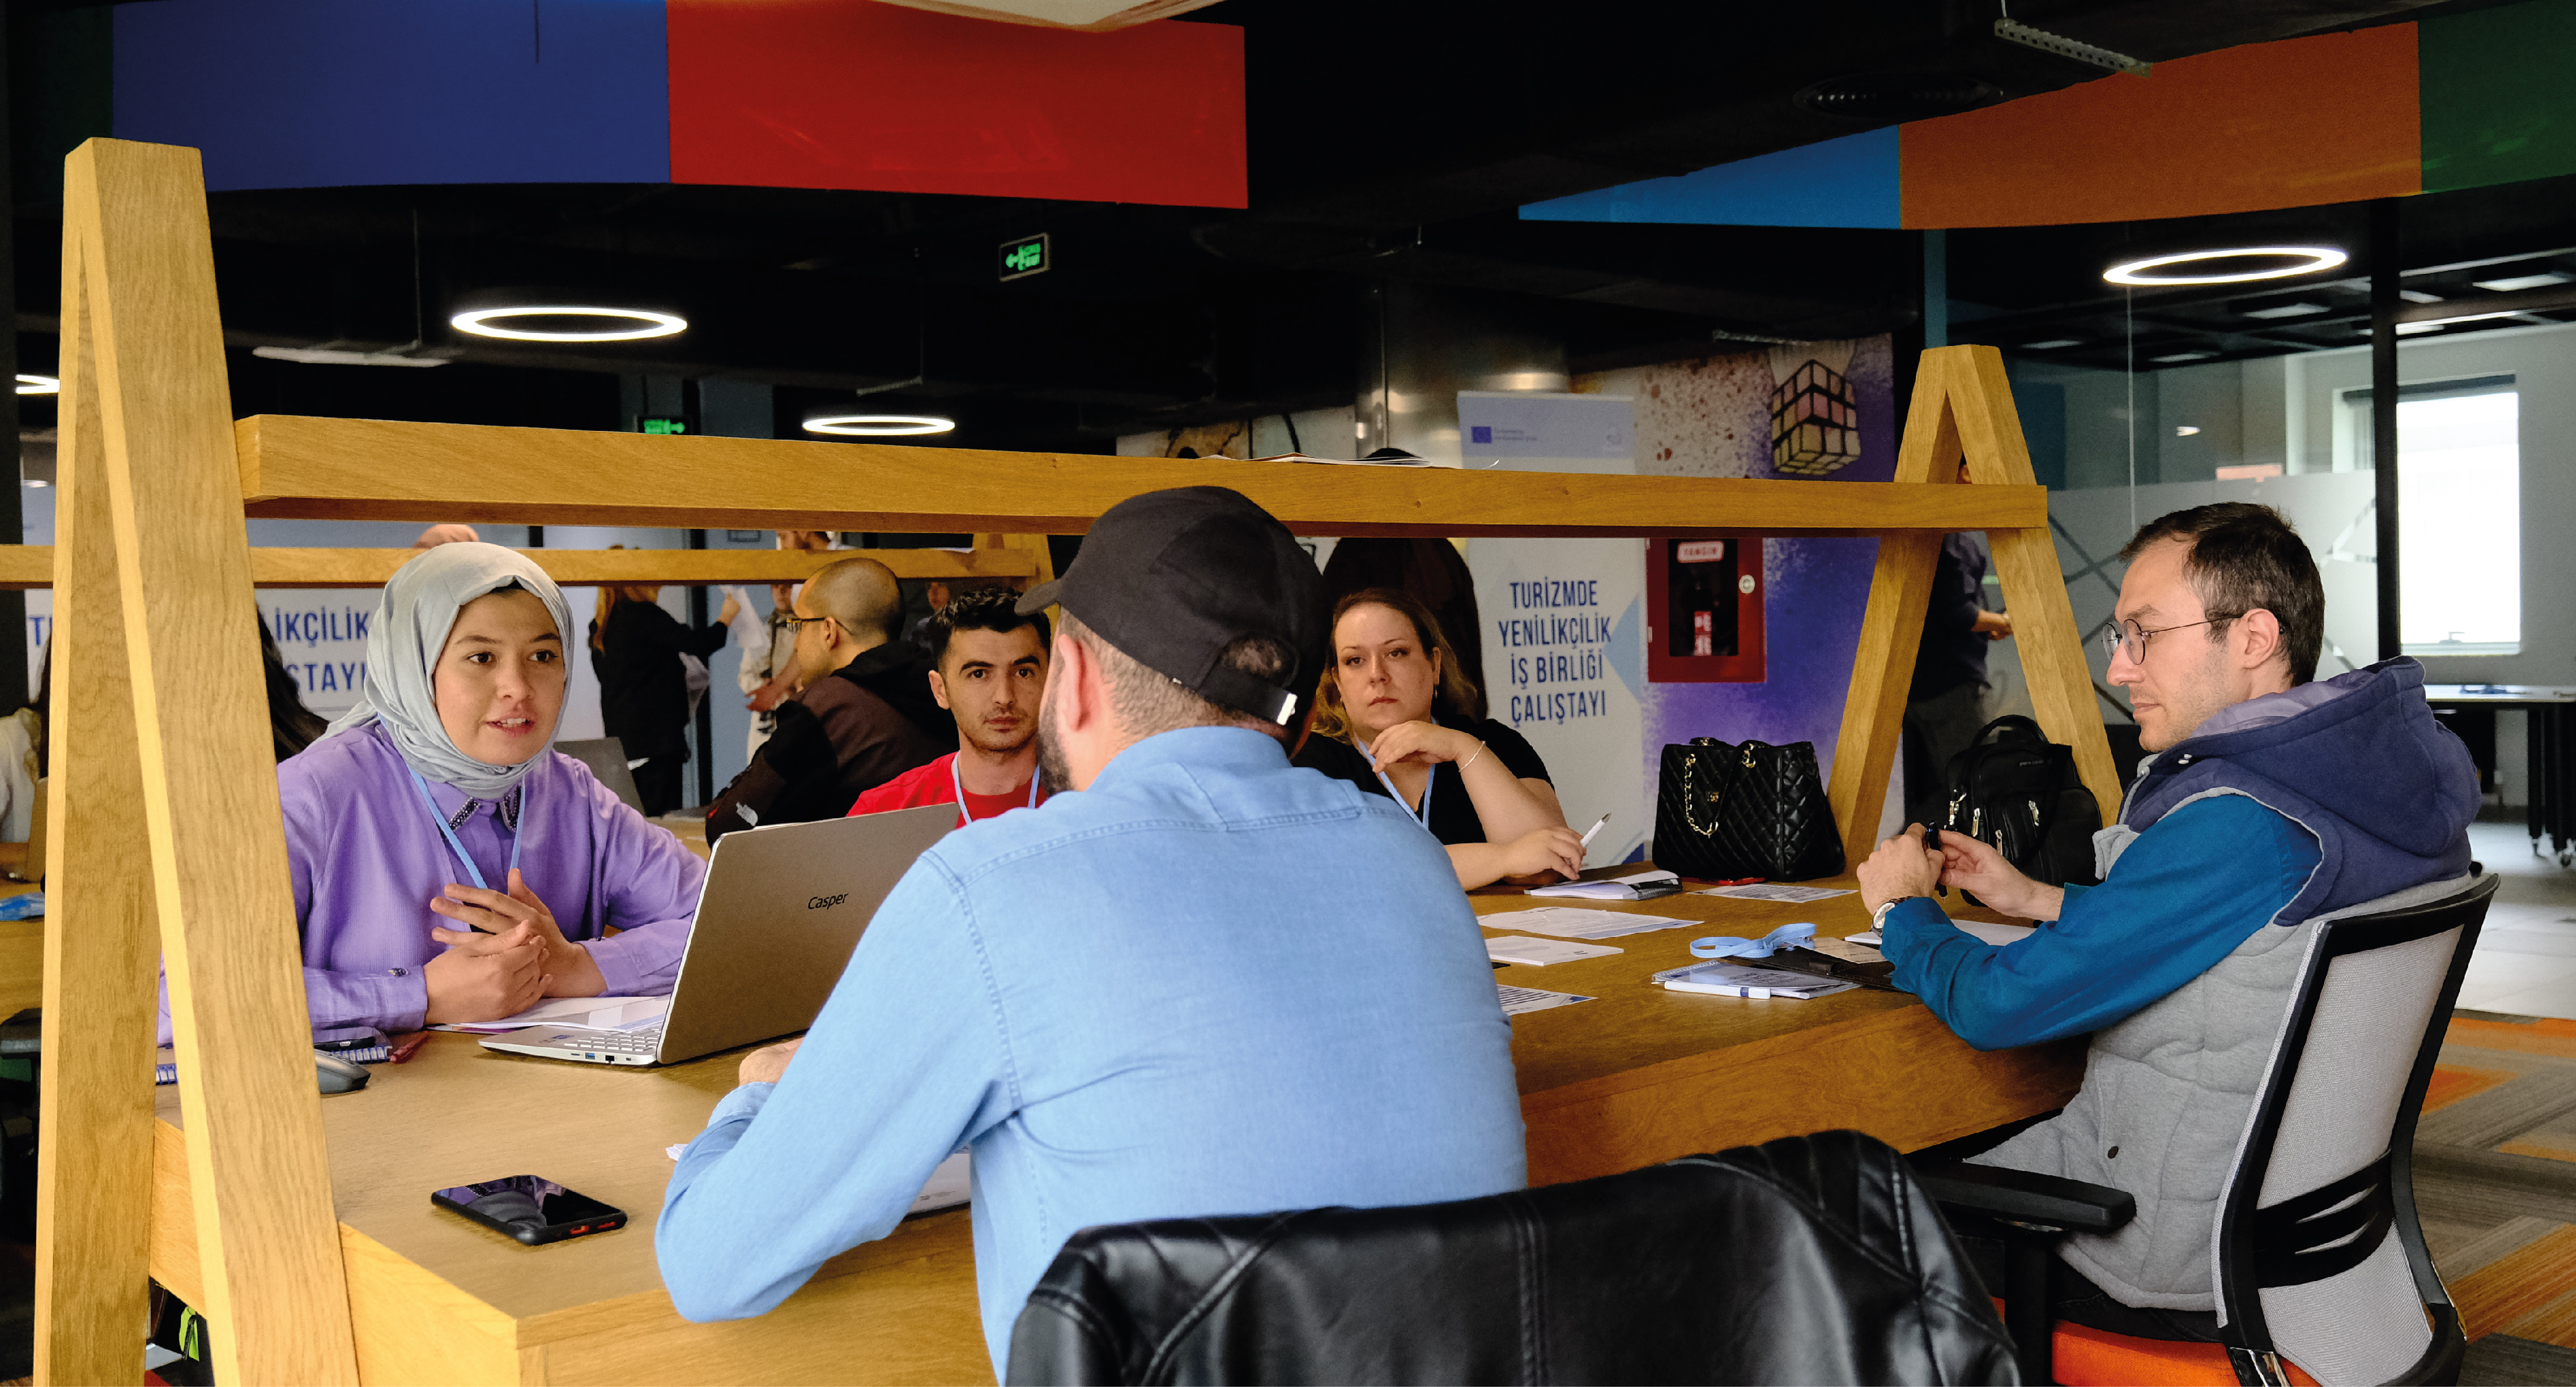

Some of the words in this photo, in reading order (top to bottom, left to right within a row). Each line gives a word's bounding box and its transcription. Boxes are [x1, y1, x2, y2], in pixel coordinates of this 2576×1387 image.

[1509, 576, 1598, 608] TURİZMDE
[276, 605, 369, 648] İKÇİLİK
[1498, 612, 1612, 649] YENİLİKÇİLİK
[1511, 653, 1528, 689] İŞ
[1536, 648, 1604, 683] BİRLİĞİ
[1511, 689, 1607, 728] ÇALIŞTAYI
[807, 893, 849, 910] Casper
